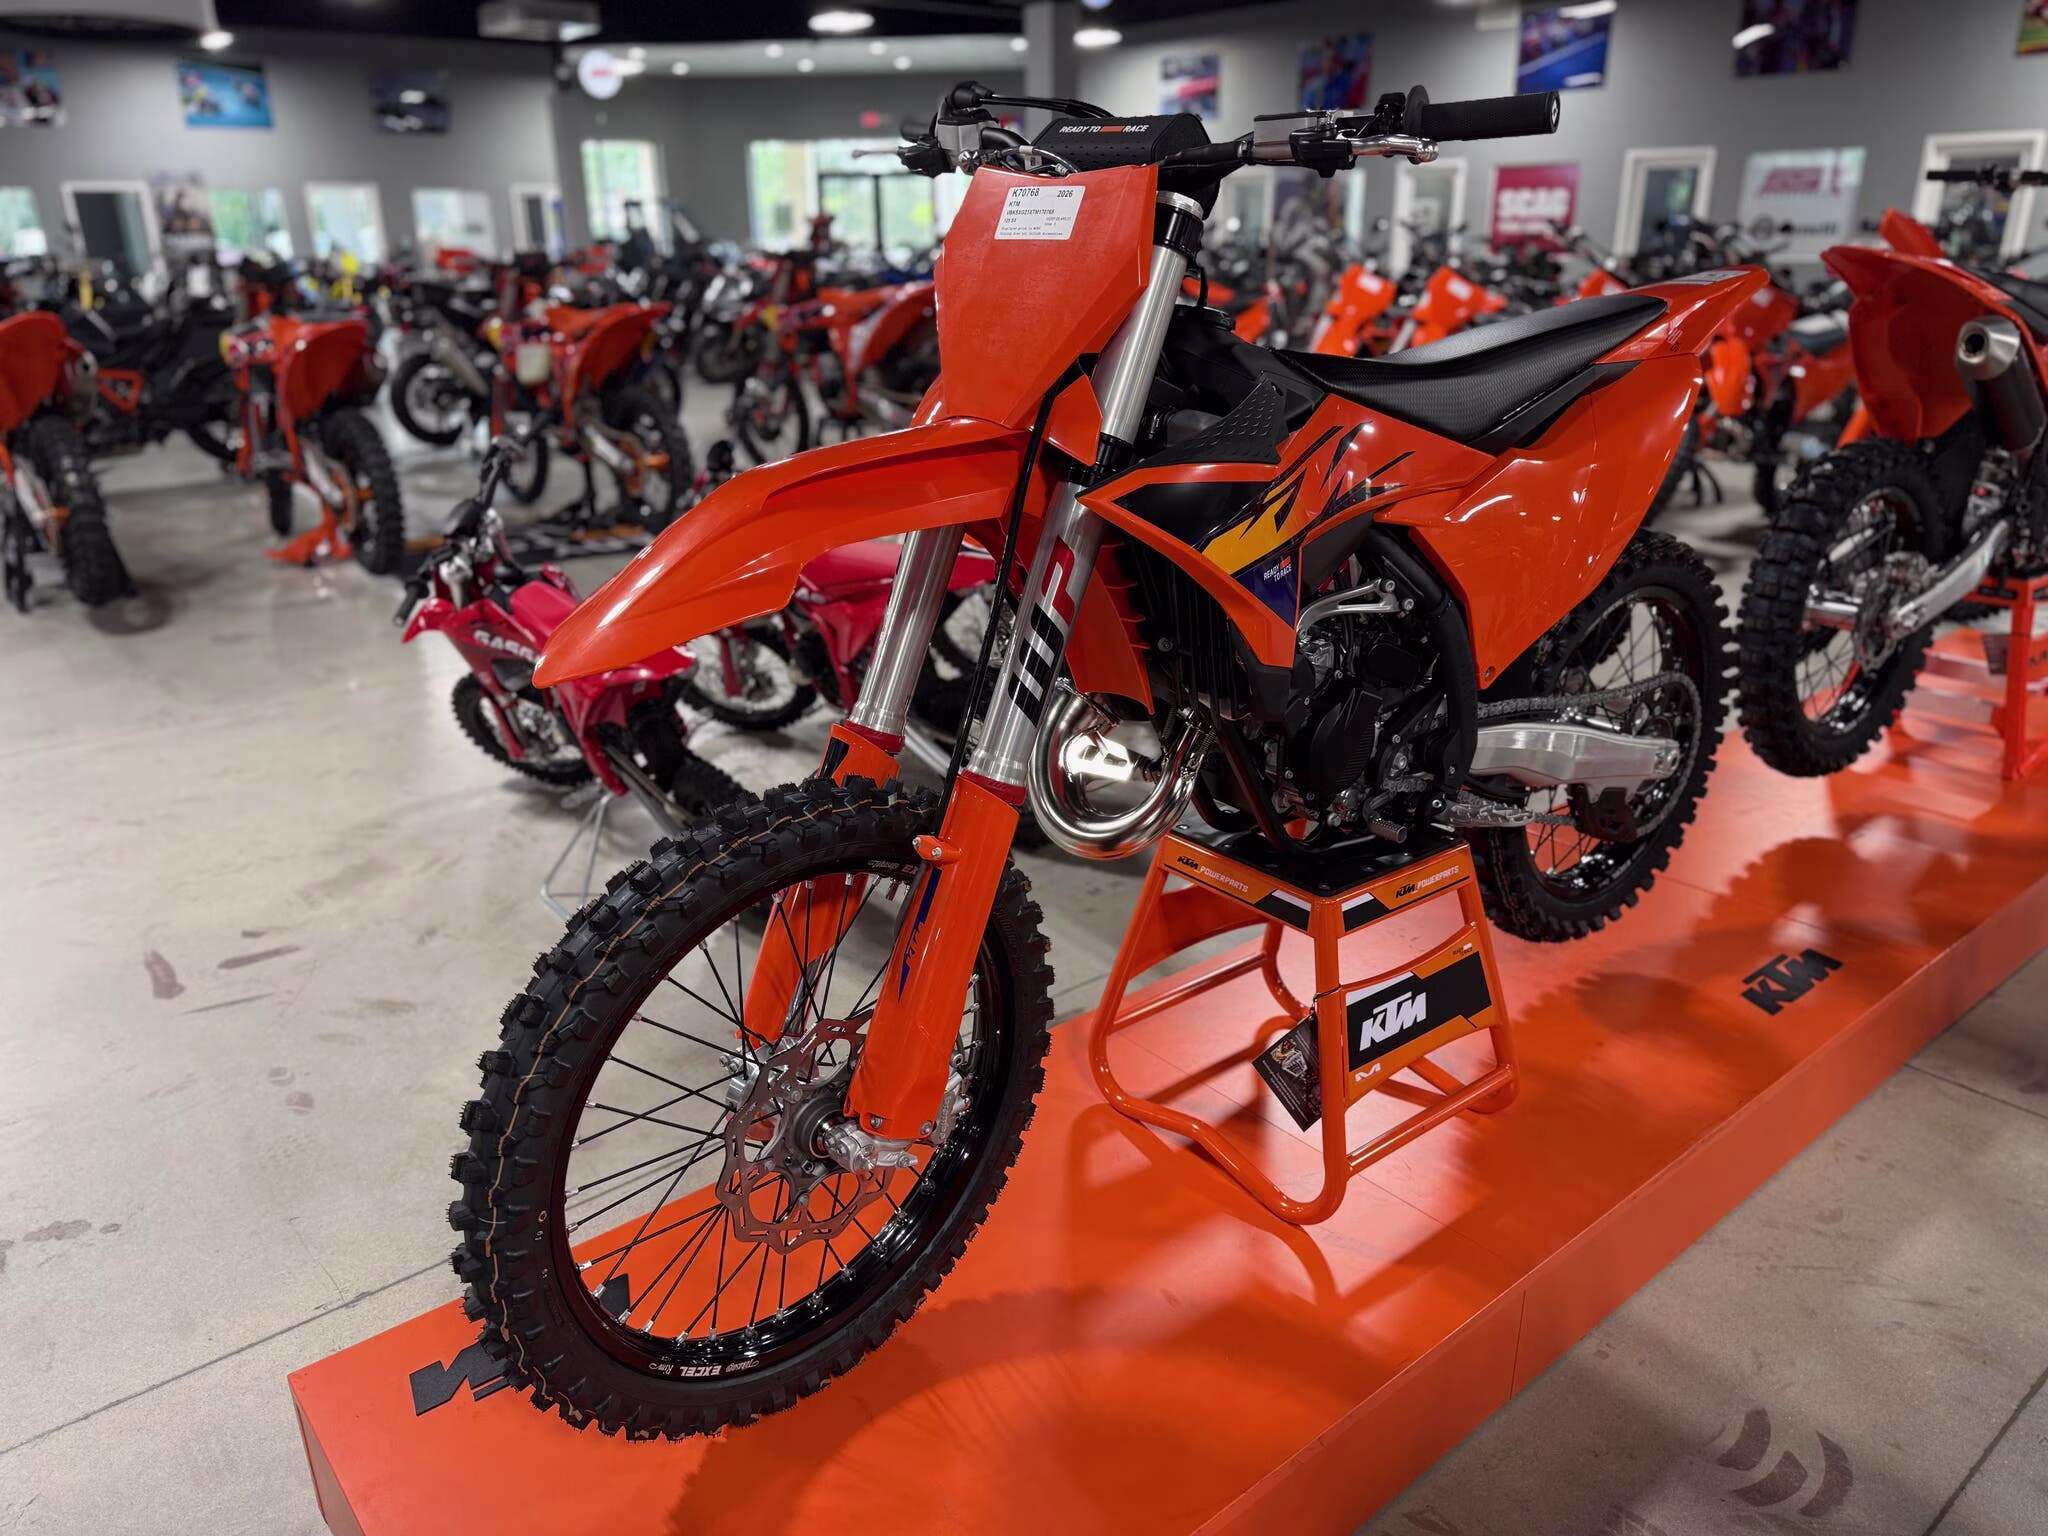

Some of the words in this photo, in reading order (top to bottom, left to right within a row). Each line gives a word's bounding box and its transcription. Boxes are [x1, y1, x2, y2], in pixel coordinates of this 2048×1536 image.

[1060, 125, 1089, 133] READY
[1088, 125, 1101, 133] TO
[1122, 124, 1149, 133] RACE
[1012, 188, 1040, 198] K70768
[1057, 190, 1074, 198] 2026
[1264, 563, 1280, 581] READY
[1280, 564, 1292, 578] RACE
[1177, 855, 1198, 870] KTM
[1199, 865, 1249, 893] POWERPARTS
[1395, 883, 1416, 899] KTM
[1417, 865, 1459, 889] POWERPARTS
[1741, 948, 1844, 1016] KTM
[1359, 991, 1427, 1052] KTM
[679, 1364, 722, 1377] EXCEL
